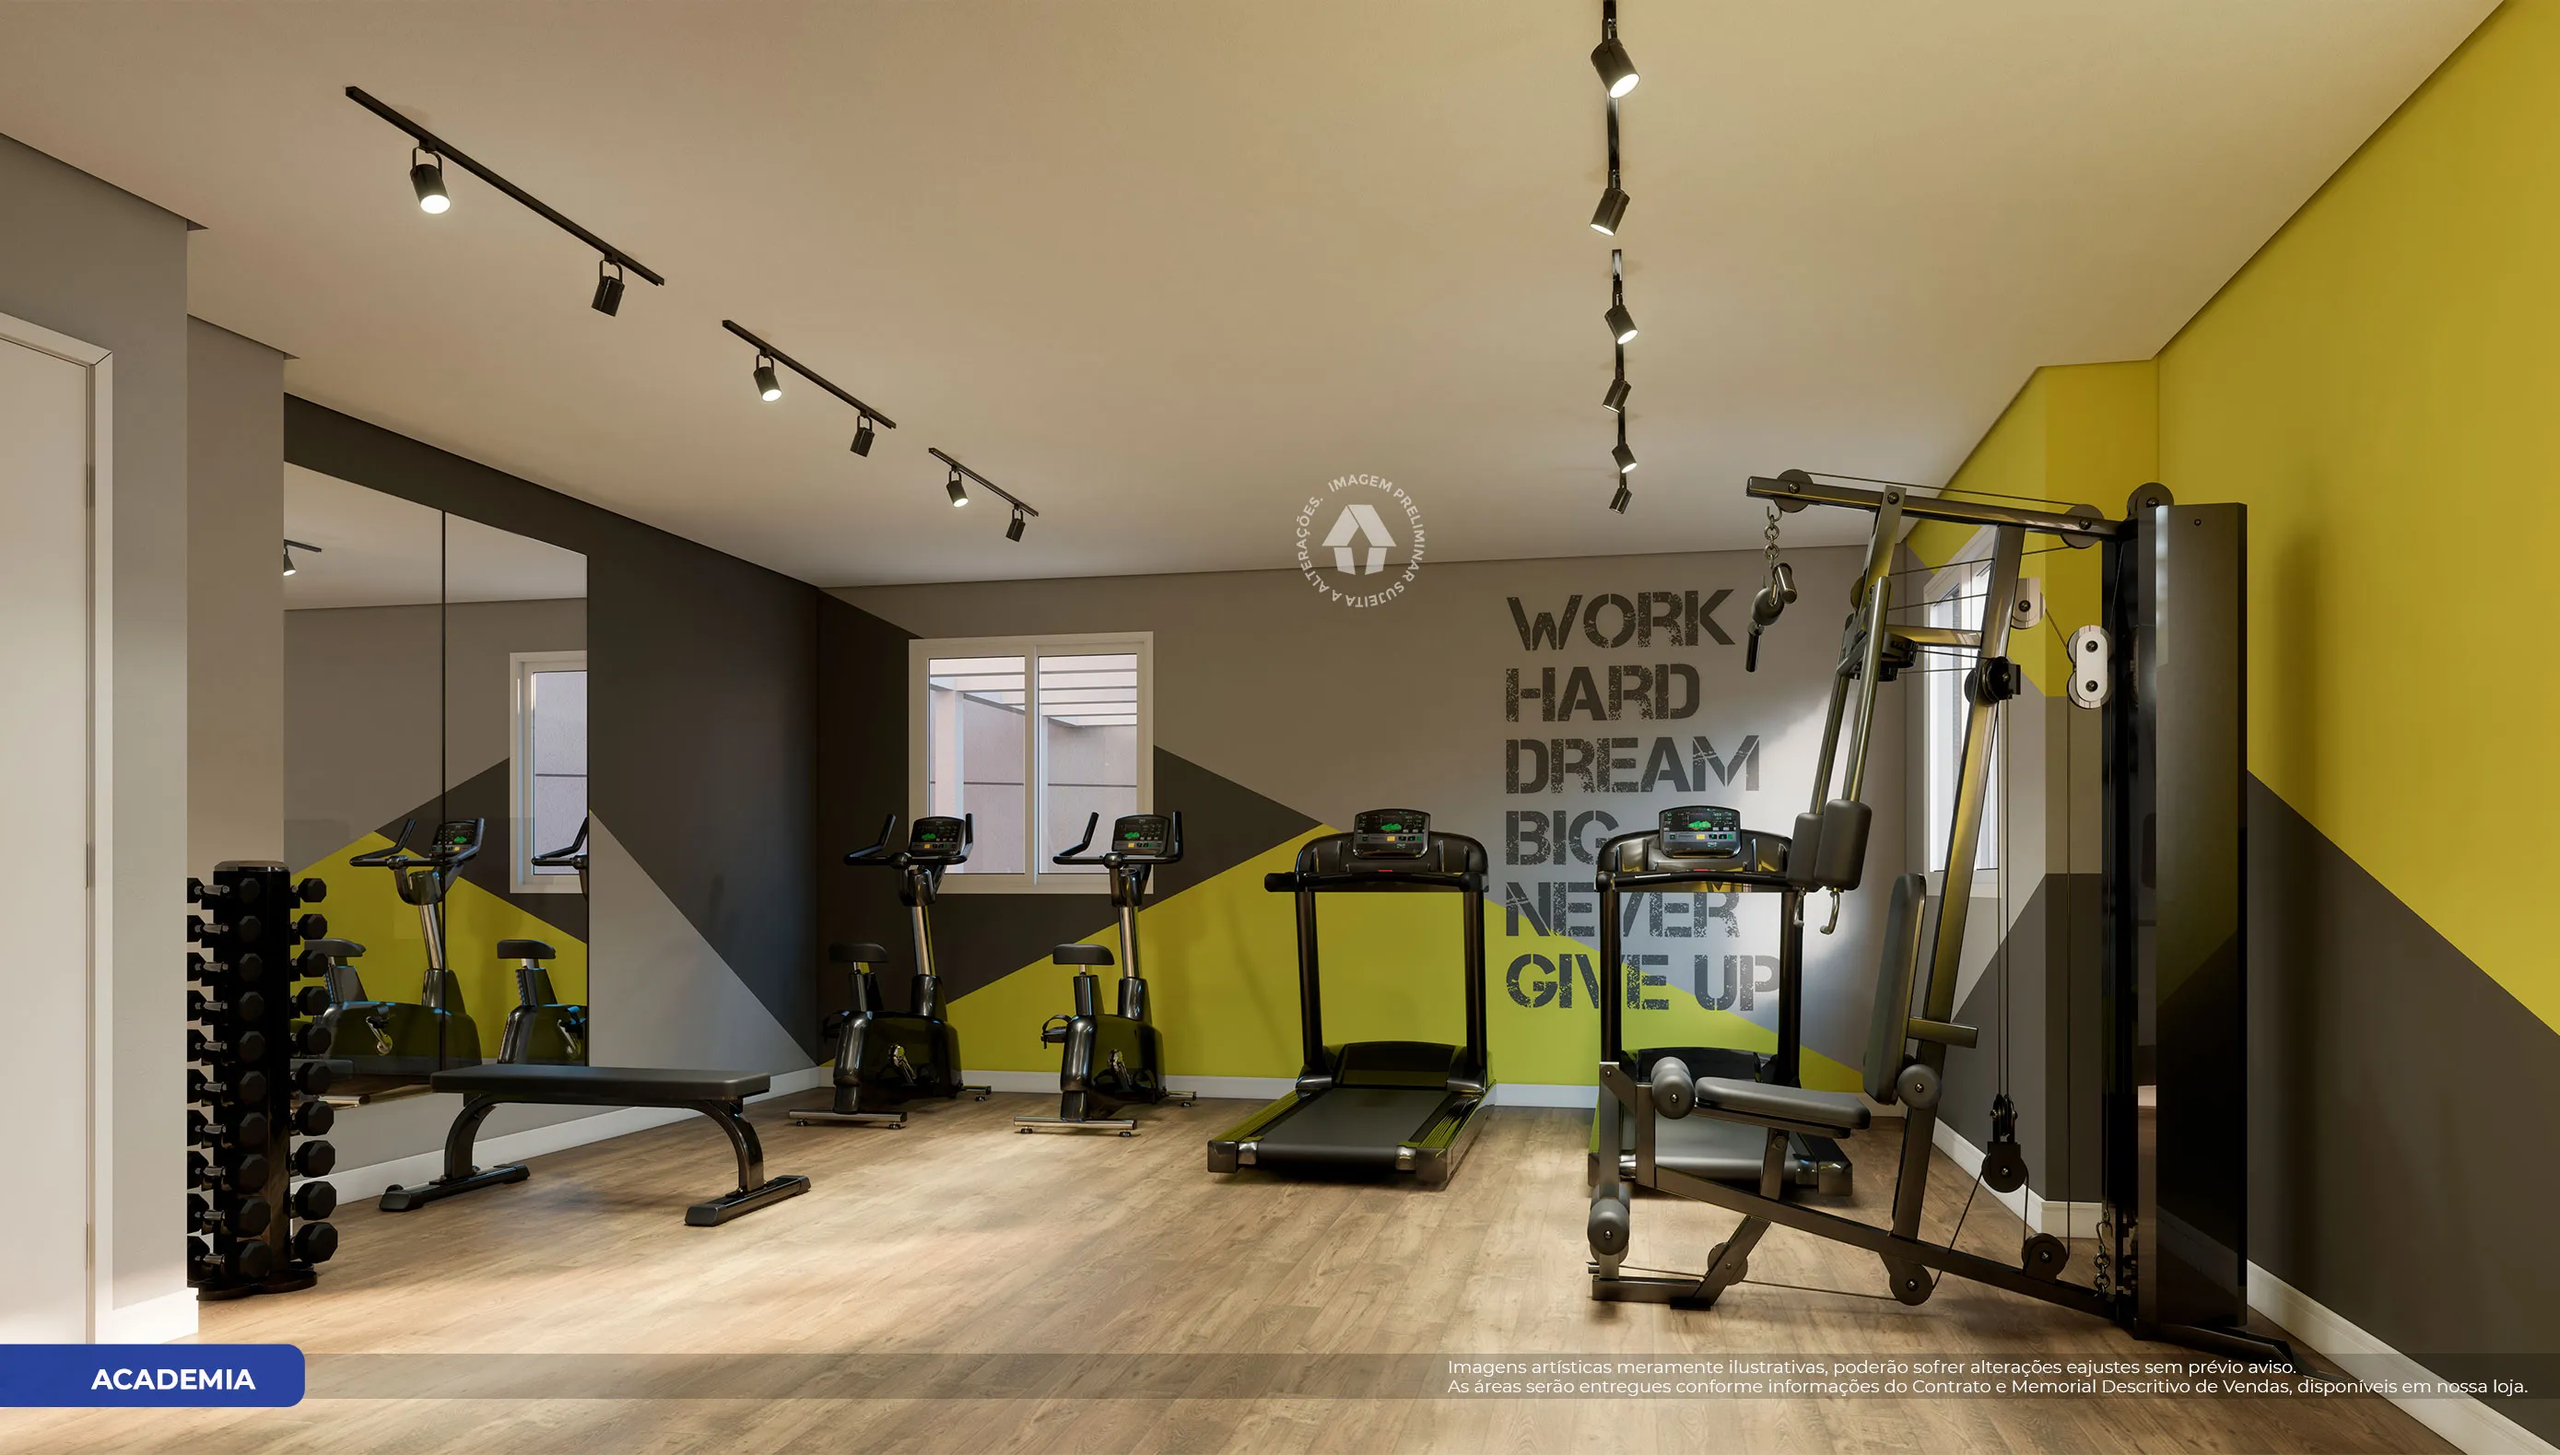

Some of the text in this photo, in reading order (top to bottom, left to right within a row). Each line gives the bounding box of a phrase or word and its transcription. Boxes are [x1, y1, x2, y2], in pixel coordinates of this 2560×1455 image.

[1506, 589, 1736, 651] WORK
[1505, 664, 1701, 723] HARD
[1505, 735, 1760, 794] DREAM
[1505, 810, 1620, 866] BIG
[1693, 954, 1780, 1012] UP
